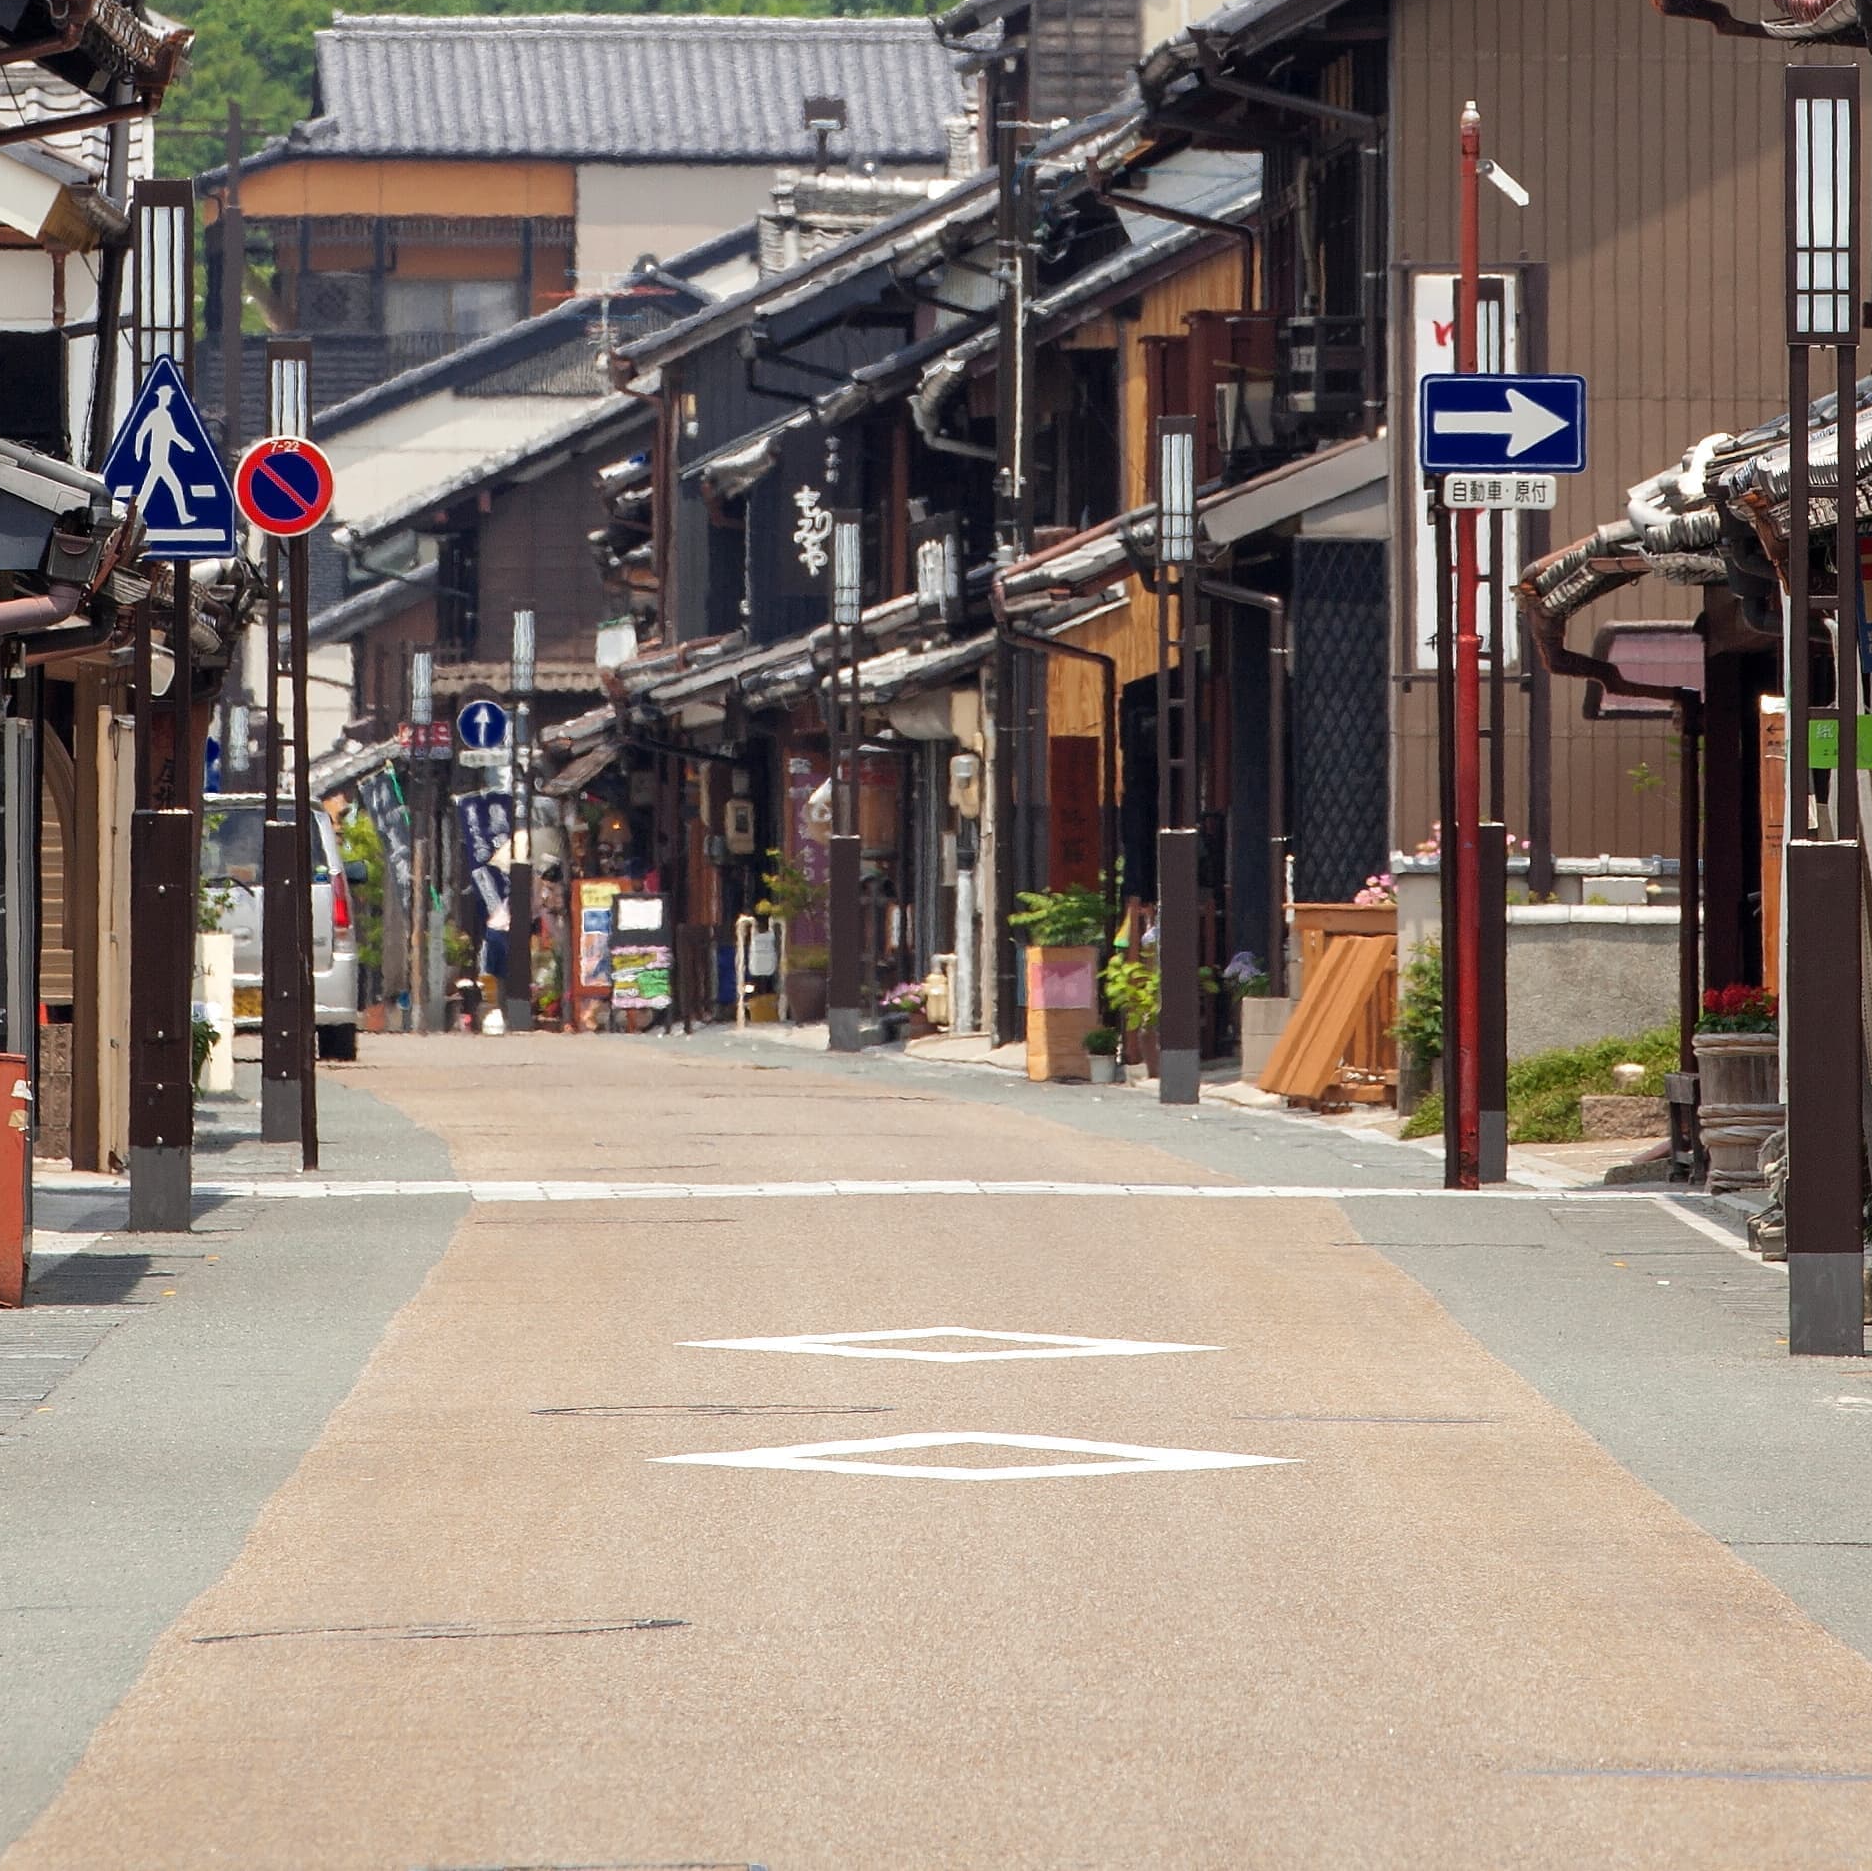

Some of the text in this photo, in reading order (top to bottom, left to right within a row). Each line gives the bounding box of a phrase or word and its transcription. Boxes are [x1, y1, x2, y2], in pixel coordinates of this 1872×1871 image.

[270, 440, 301, 454] 7-22
[1452, 480, 1548, 505] 自動車・原付
